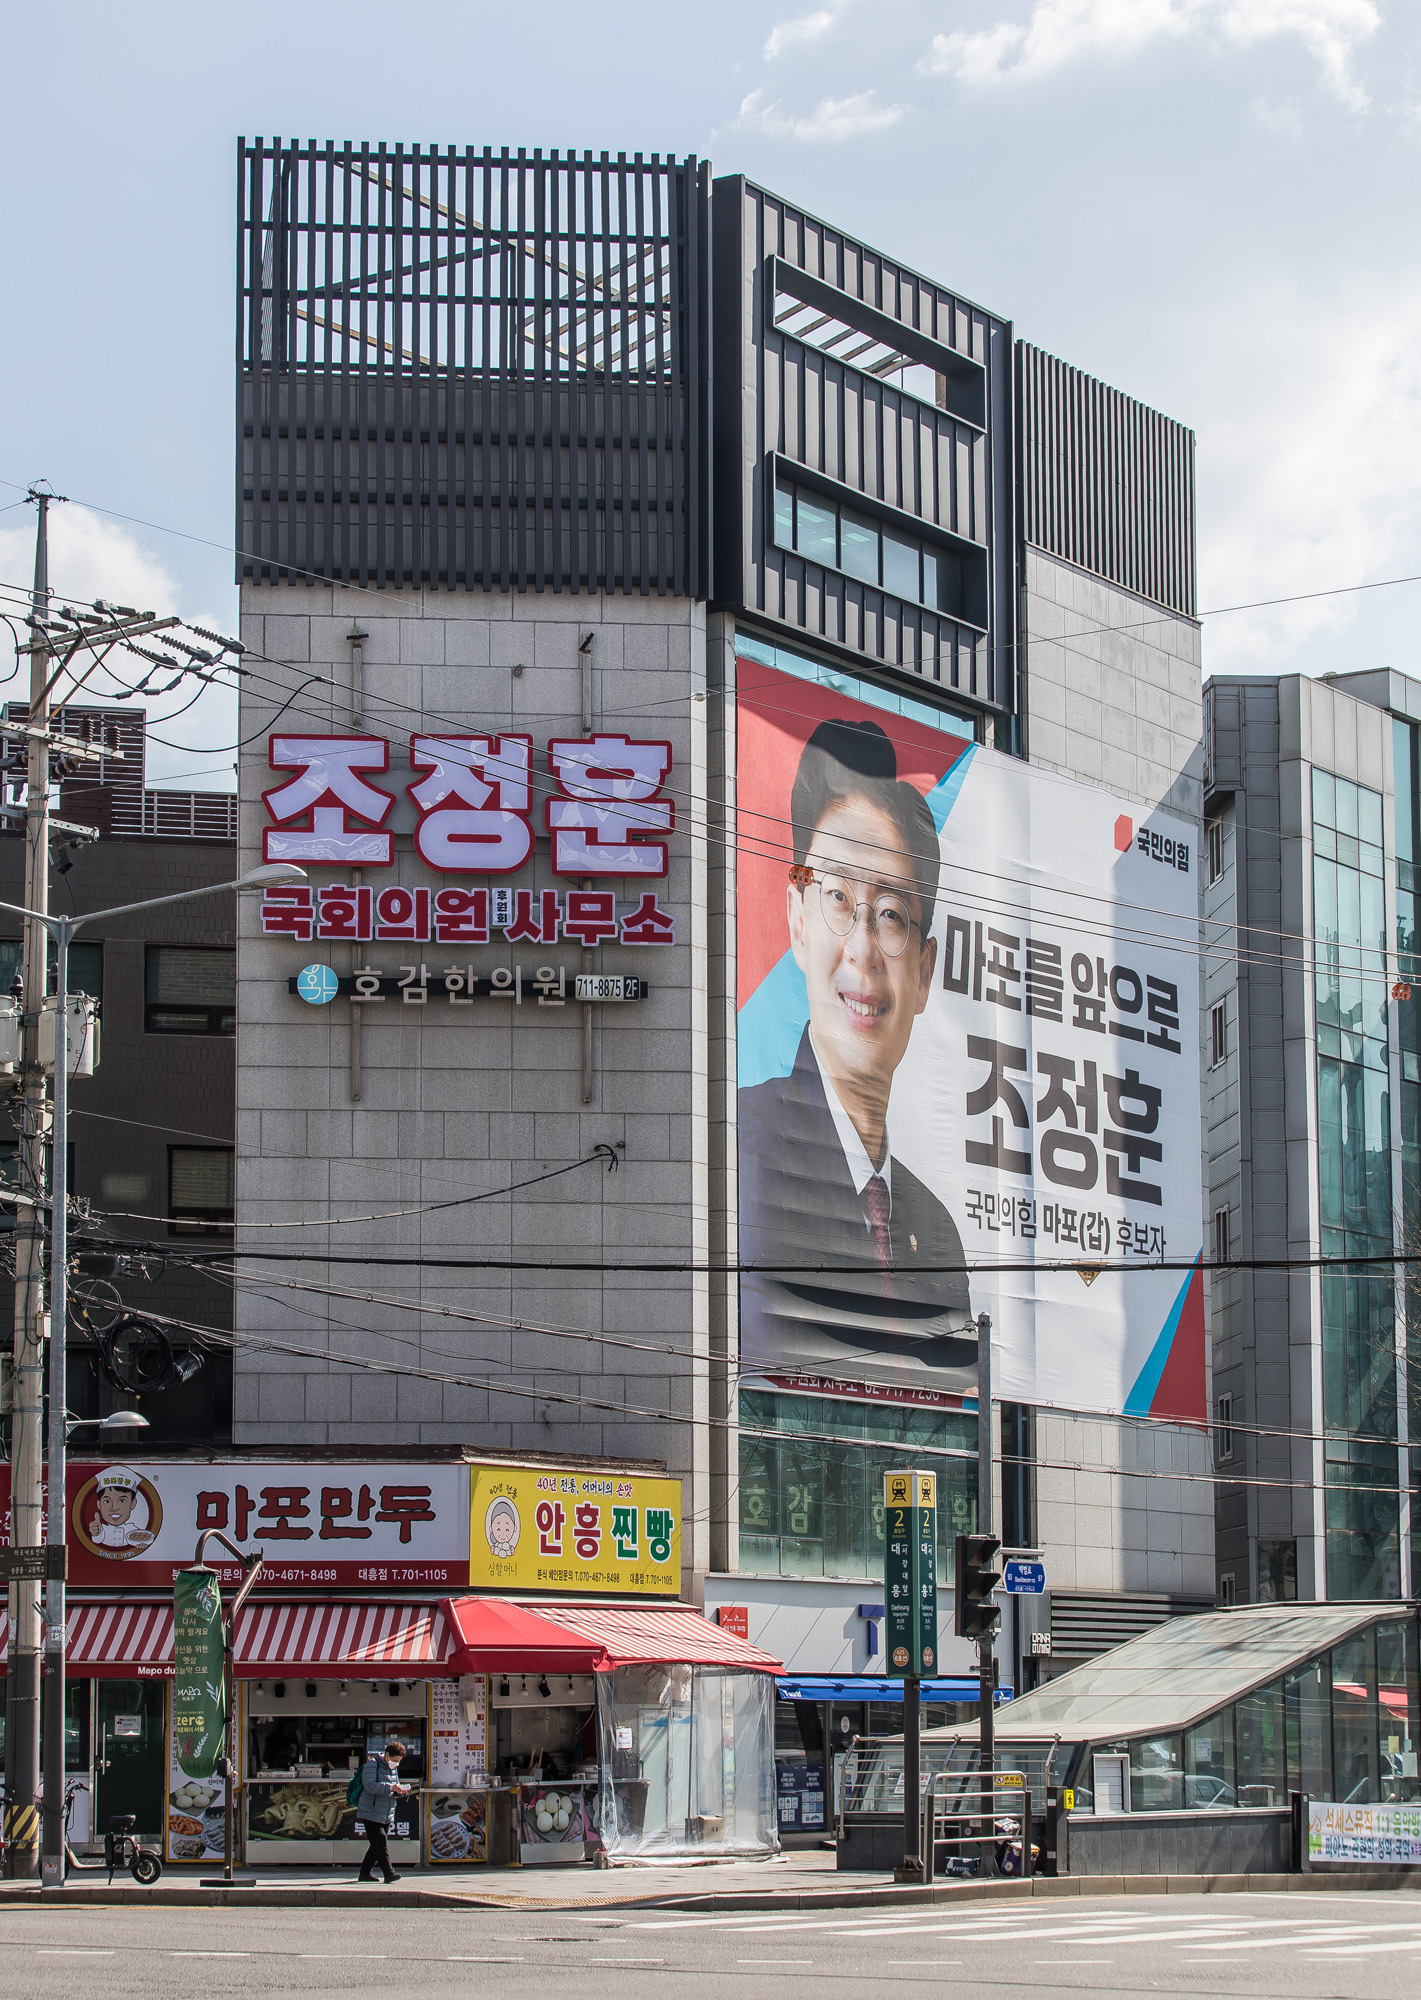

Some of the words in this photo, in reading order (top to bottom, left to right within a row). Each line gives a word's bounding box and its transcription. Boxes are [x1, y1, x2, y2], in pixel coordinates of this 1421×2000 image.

[261, 733, 676, 878] 조정훈
[1137, 826, 1190, 874] 국민의힘
[260, 884, 490, 943] 국회의원
[496, 890, 508, 923] 후원회
[504, 888, 676, 946] 사무소
[350, 963, 566, 1006] 호감한의원
[576, 977, 622, 998] 711-8875
[625, 978, 638, 998] 2F
[943, 915, 1064, 1023] 마포를
[1070, 952, 1181, 1055] 앞으로
[965, 1033, 1163, 1206] 조정훈
[964, 1189, 1037, 1240] 국민의힘
[1043, 1203, 1111, 1256] 마포(갑)
[1116, 1218, 1166, 1263] 후보자
[536, 1476, 557, 1492] 40년
[559, 1477, 580, 1497] 전통,
[581, 1479, 614, 1497] 어머니의
[615, 1481, 633, 1498] 손맛
[196, 1484, 436, 1544] 마포만두
[895, 1510, 904, 1526] 2
[924, 1510, 930, 1526] 2
[99, 1550, 117, 1559] SINCE
[120, 1550, 135, 1558] 1995
[358, 1568, 388, 1581] 대흥점
[392, 1569, 448, 1580] T.701-1105
[574, 1571, 620, 1584] T.070-4671-8498
[1018, 1564, 1032, 1576] 백범로
[182, 1617, 196, 1626] 다시
[194, 1645, 208, 1654] 위한
[138, 1666, 161, 1676] Mapo
[194, 1666, 208, 1674] 으로
[354, 1821, 410, 1836] 부오뎅
[1325, 1807, 1373, 1835] 석세스뮤직
